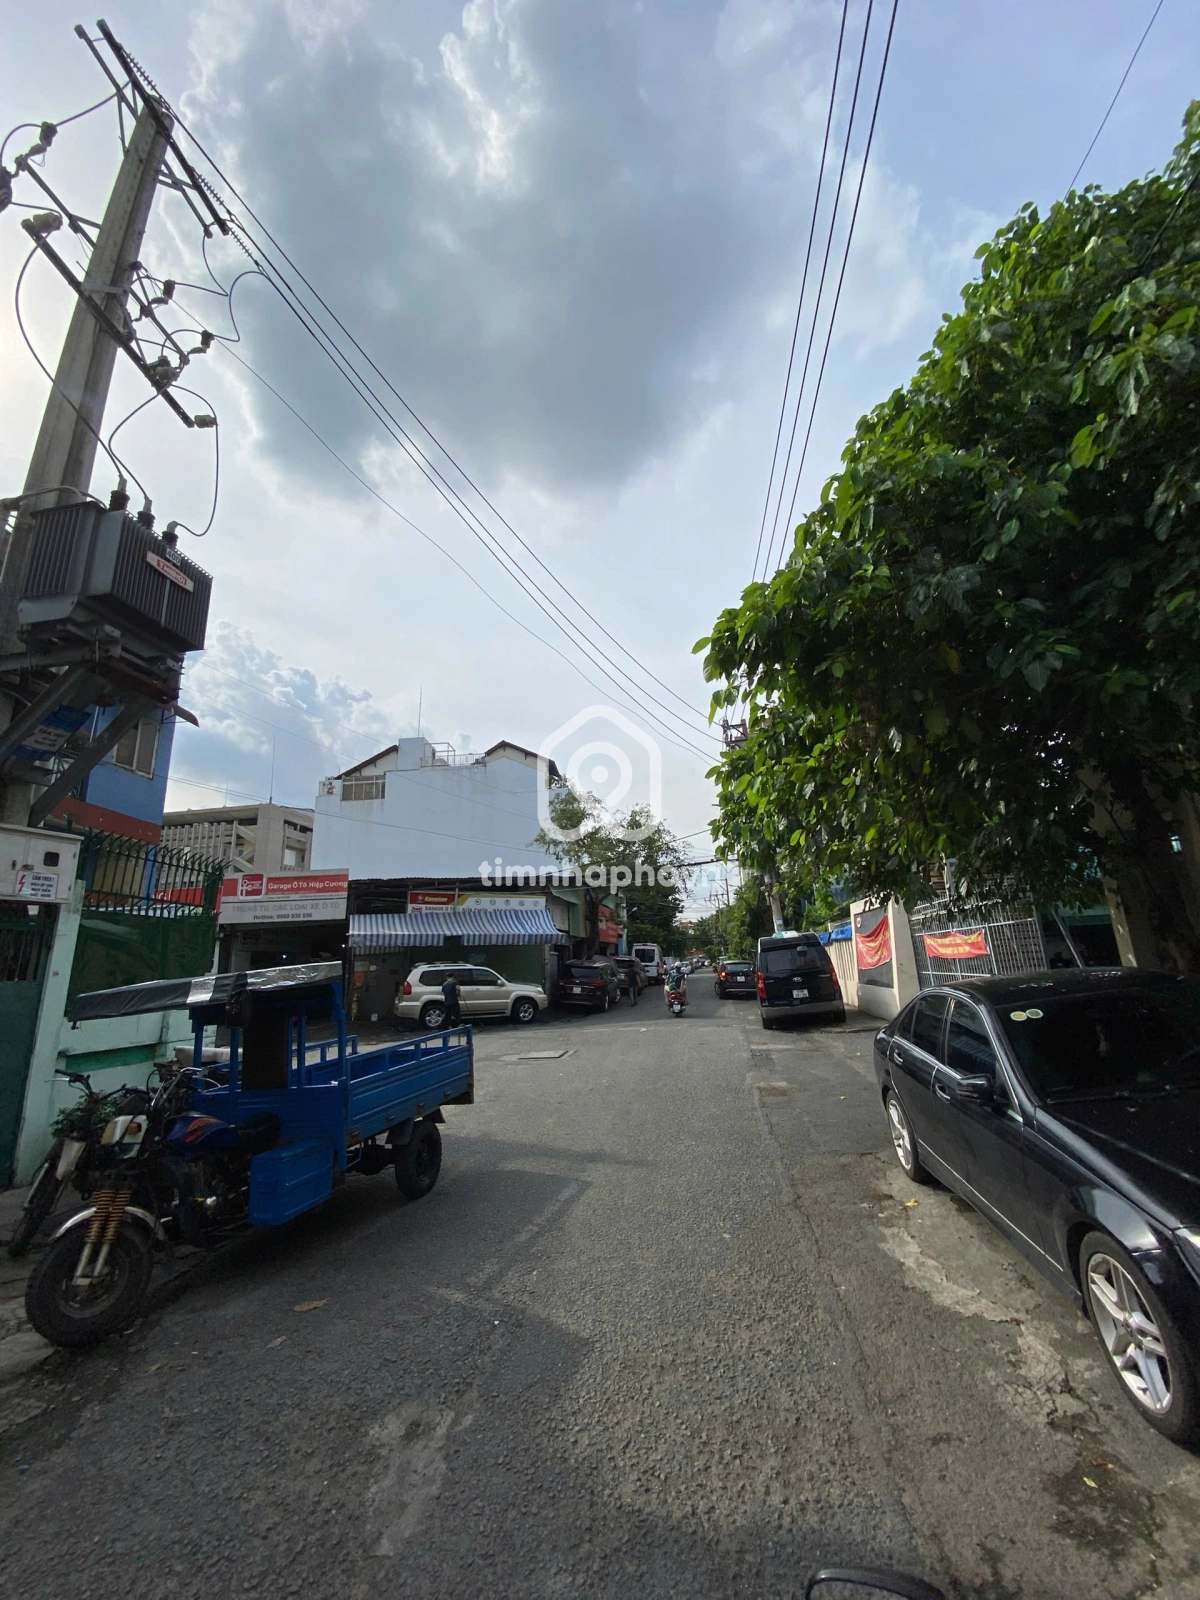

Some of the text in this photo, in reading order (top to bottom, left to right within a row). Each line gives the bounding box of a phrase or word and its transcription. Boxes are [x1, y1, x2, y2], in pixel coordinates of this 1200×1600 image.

[166, 550, 181, 565] 400
[268, 882, 291, 890] Garage
[308, 881, 324, 889] Hiệp
[310, 902, 320, 910] XE
